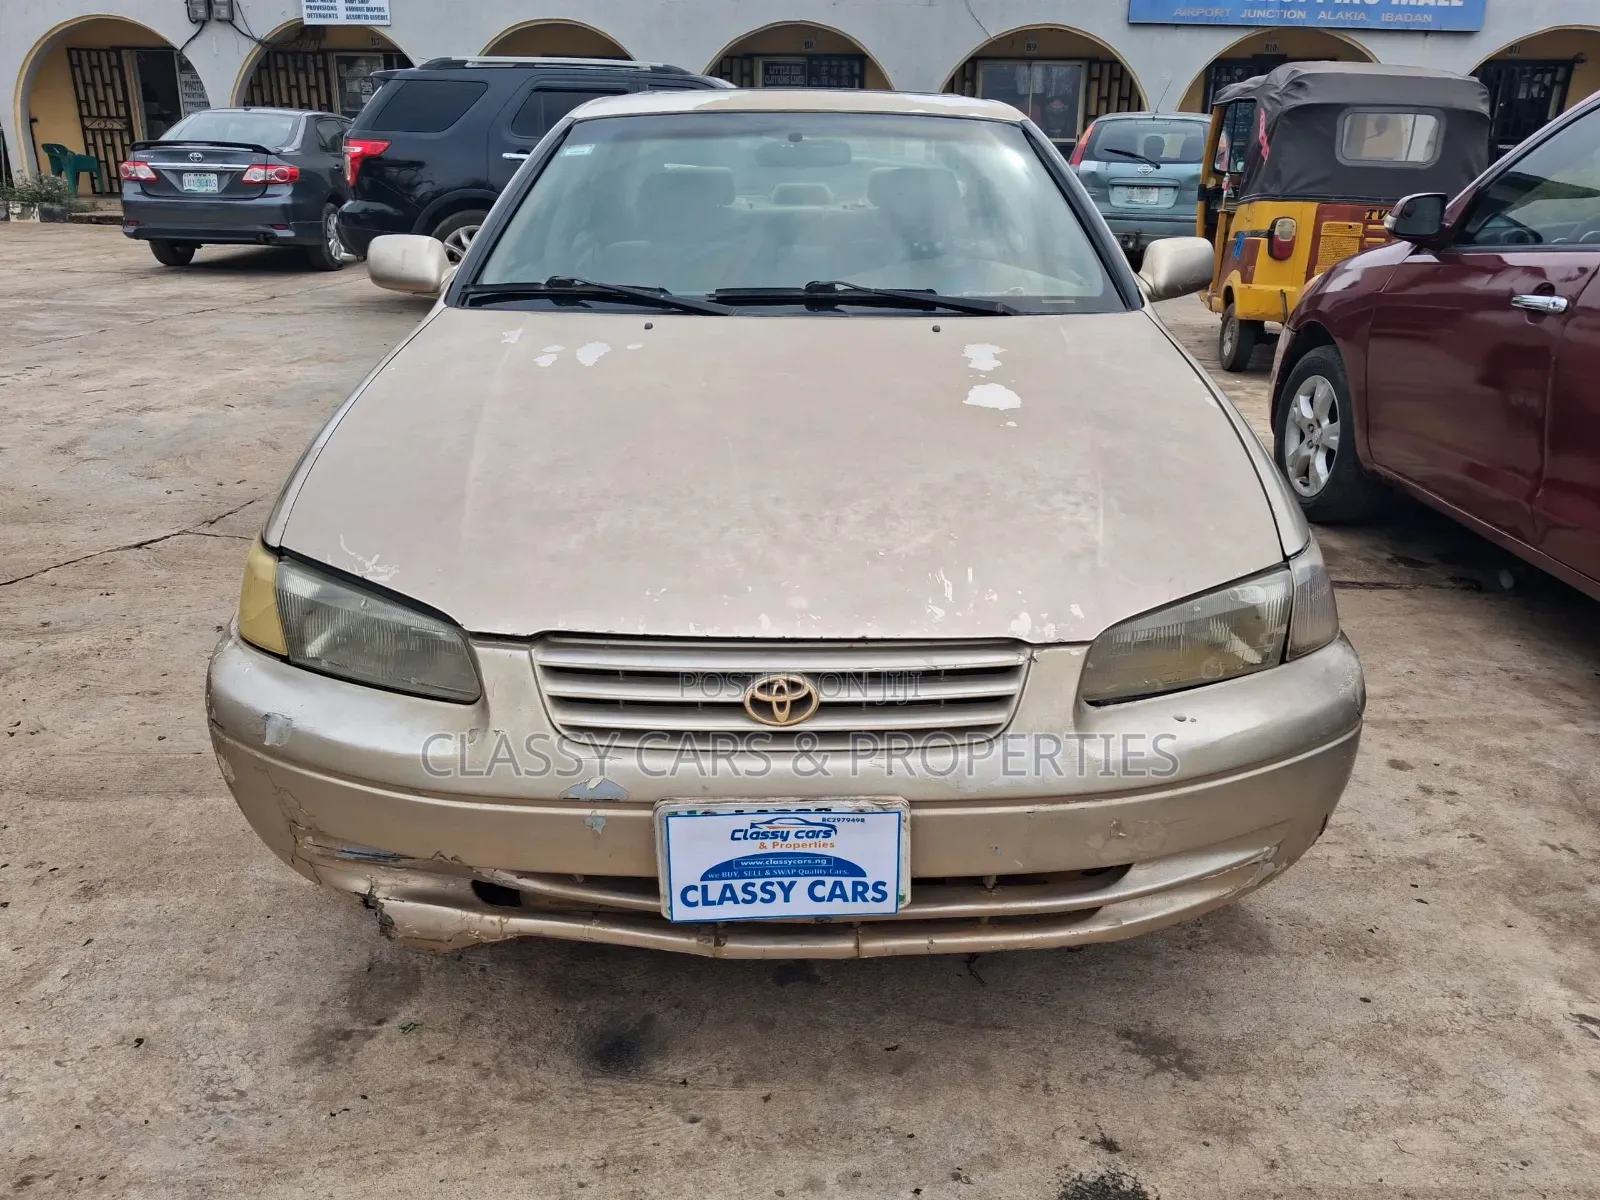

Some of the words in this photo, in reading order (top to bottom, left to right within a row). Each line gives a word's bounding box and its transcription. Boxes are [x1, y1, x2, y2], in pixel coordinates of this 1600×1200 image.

[1173, 8, 1231, 17] AIRPORT
[1240, 9, 1306, 19] JUNCTION
[1381, 12, 1433, 22] IBADAN
[1365, 209, 1391, 220] TV
[730, 829, 790, 841] Classy
[794, 829, 833, 839] cars
[758, 841, 768, 850] &
[772, 841, 835, 850] Properties
[740, 858, 827, 866] www.classycars.ng
[798, 868, 827, 876] Quality
[680, 880, 798, 908] CLASSY
[807, 879, 888, 904] CARS
